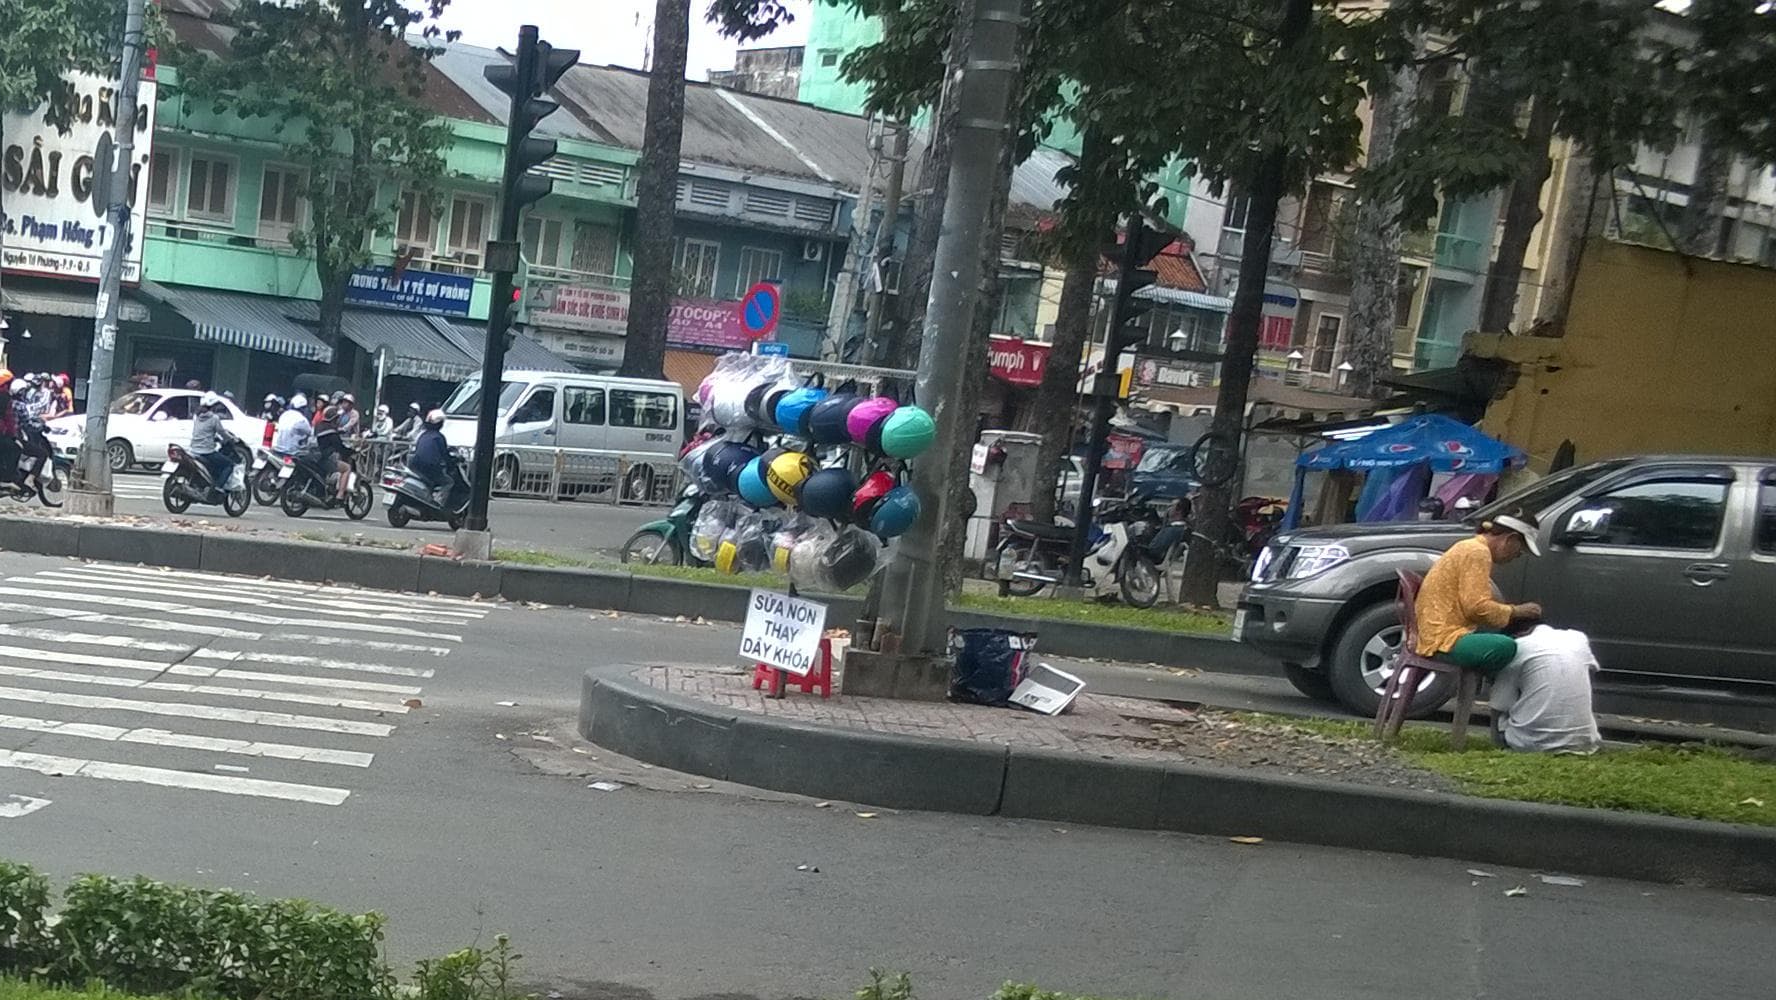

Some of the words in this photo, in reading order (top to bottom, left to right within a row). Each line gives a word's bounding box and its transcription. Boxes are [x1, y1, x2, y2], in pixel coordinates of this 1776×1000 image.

[21, 215, 58, 244] Phạm
[61, 220, 94, 249] Hồng
[404, 280, 410, 293] Y
[411, 277, 426, 295] TẾ
[440, 282, 471, 301] PHÒNG
[754, 593, 784, 617] SỬA
[786, 602, 817, 625] NÓN
[765, 620, 800, 643] THAY
[742, 636, 772, 658] DÂY
[773, 646, 810, 669] KHÓA
